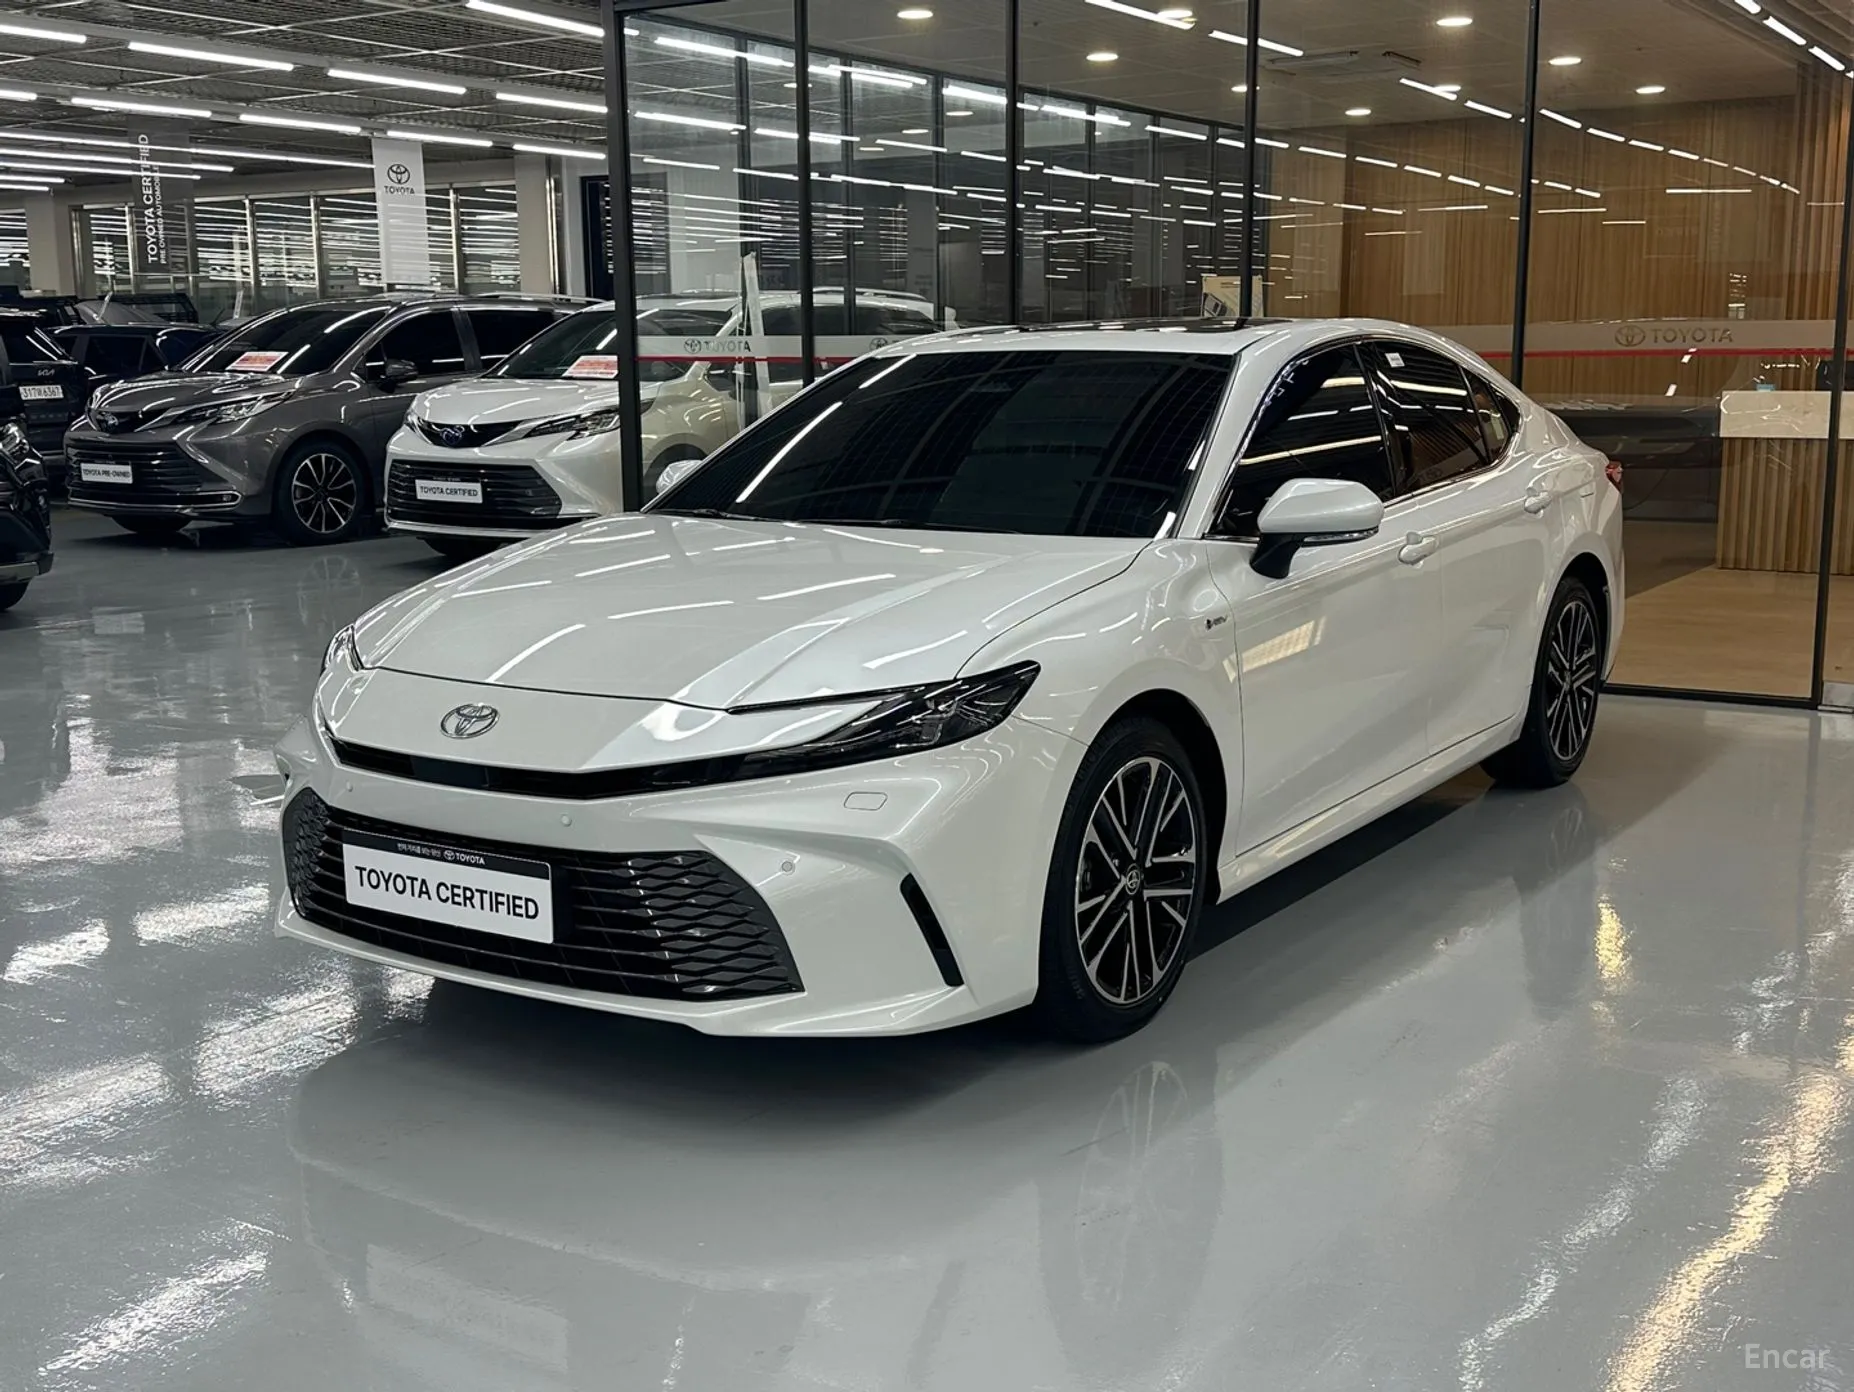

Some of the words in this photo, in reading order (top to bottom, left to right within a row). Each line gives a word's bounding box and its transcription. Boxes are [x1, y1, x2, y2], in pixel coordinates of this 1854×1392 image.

[138, 134, 154, 205] CERTIFIED
[384, 185, 415, 195] TOYOTA
[144, 207, 158, 263] TOYOTA
[1651, 328, 1733, 343] TOYOTA
[420, 486, 444, 494] TOYOTA
[445, 487, 478, 497] CERTIFIED
[455, 853, 486, 865] TOYOTA
[354, 865, 432, 901] TOYOTA
[436, 881, 539, 920] CERTIFIED
